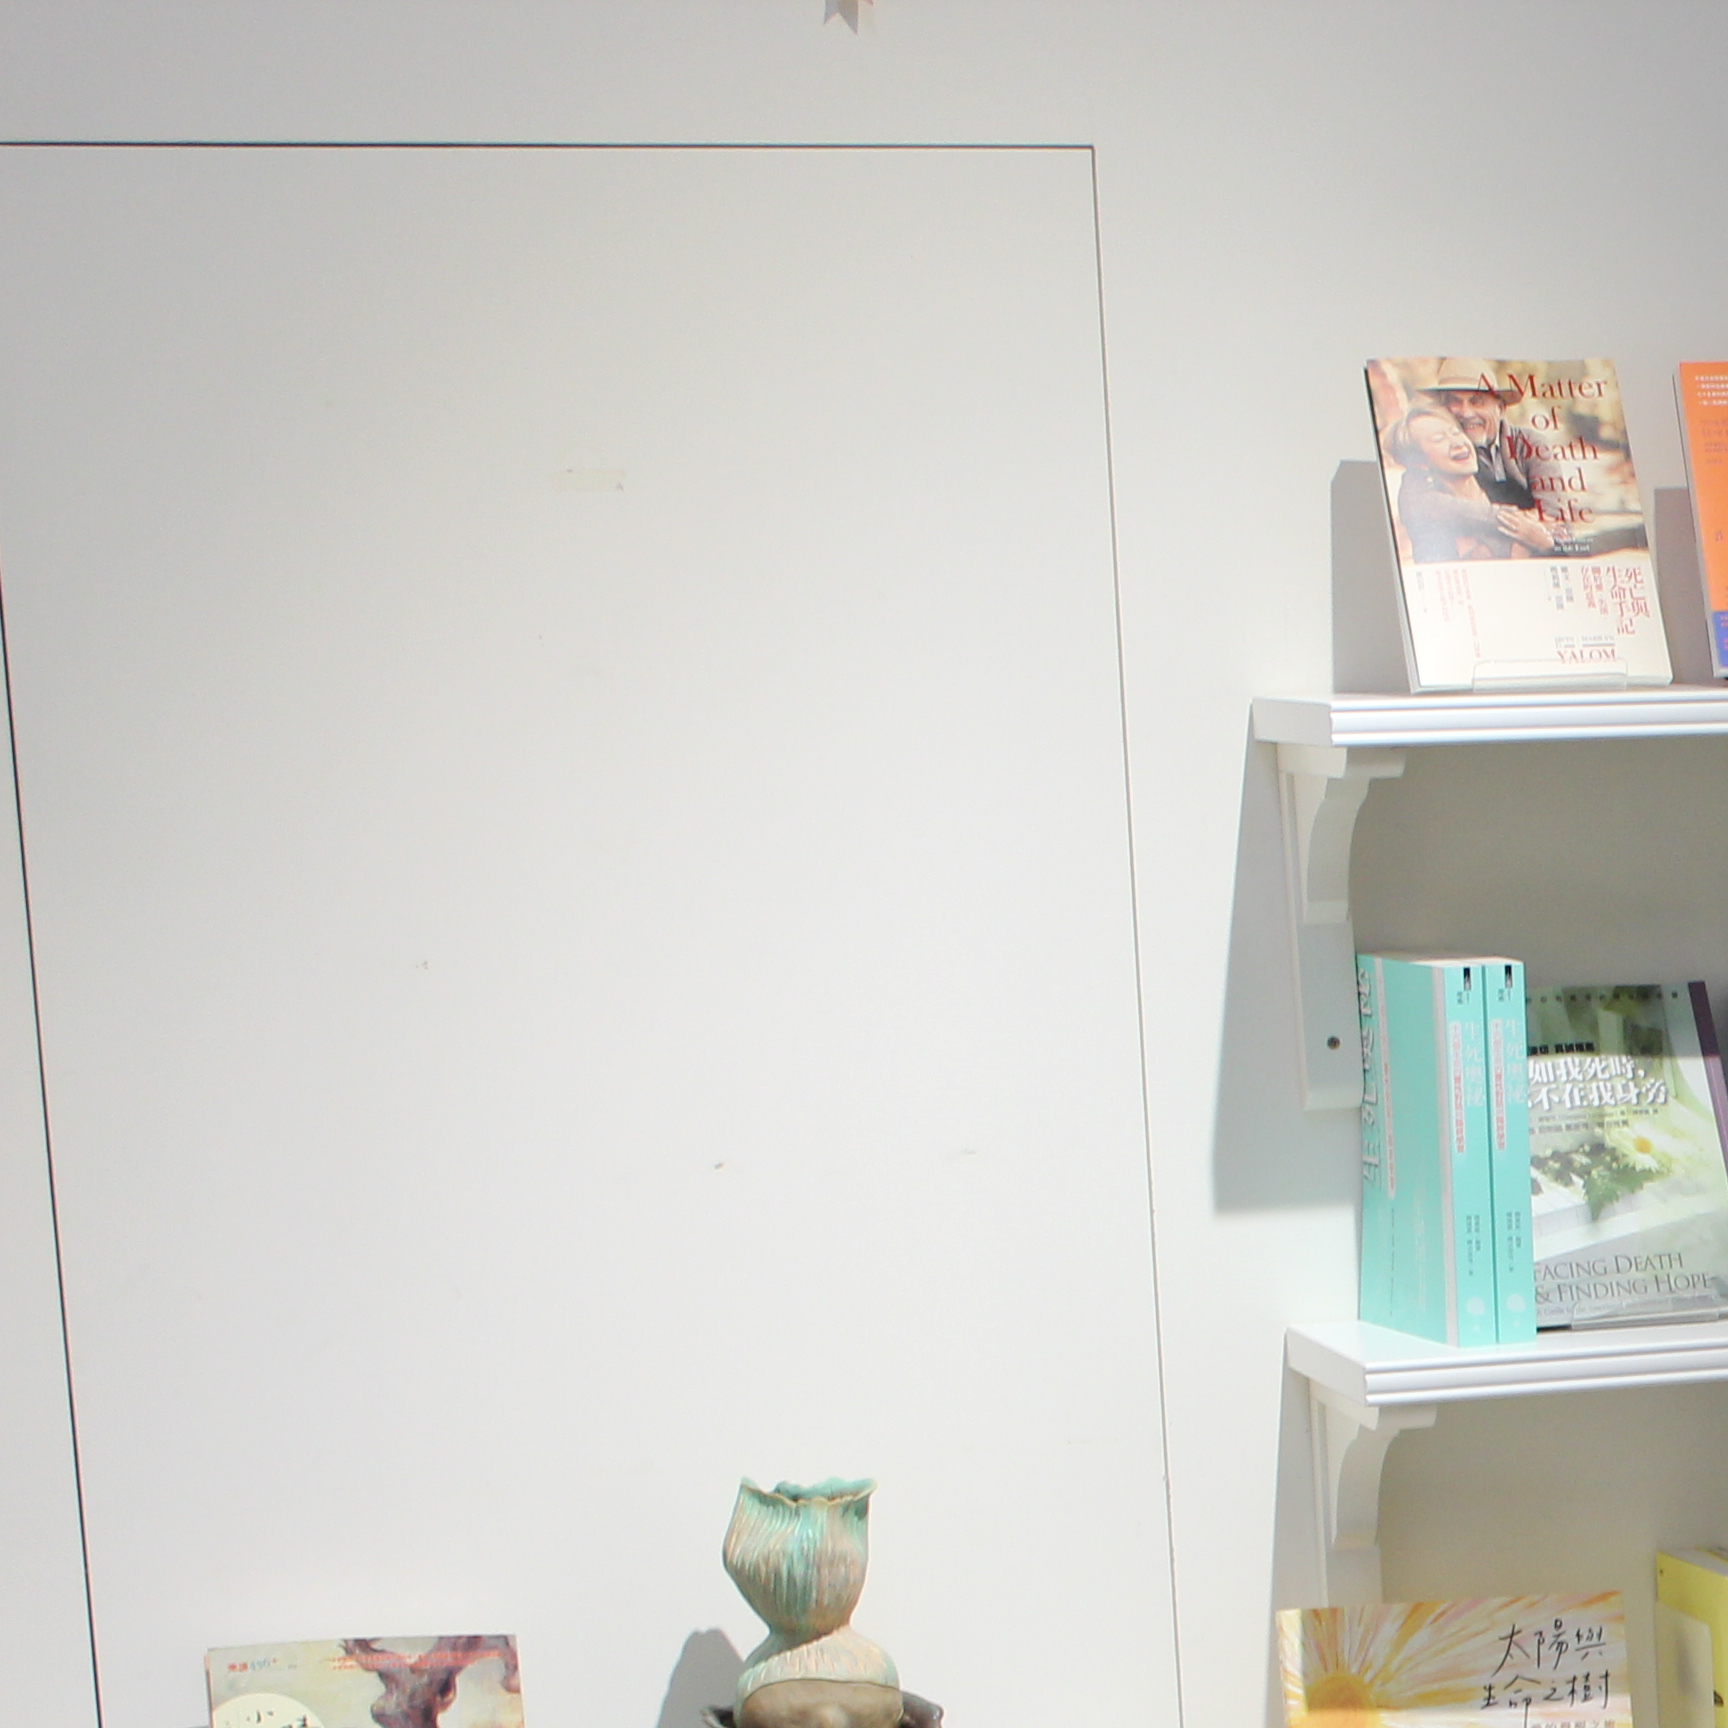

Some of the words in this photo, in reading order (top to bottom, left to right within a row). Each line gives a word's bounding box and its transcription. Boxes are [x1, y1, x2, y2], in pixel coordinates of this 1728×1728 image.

[1476, 372, 1497, 397] A
[1506, 373, 1608, 400] Matter
[1530, 406, 1562, 431] of
[1505, 436, 1600, 461] Death
[1529, 467, 1587, 493] and
[1535, 499, 1594, 524] Life
[1557, 649, 1617, 664] YALOM
[1534, 1260, 1607, 1282] FACING
[1614, 1252, 1684, 1274] DEATH
[1557, 1278, 1649, 1302] FINDING
[1491, 1618, 1608, 1677] 太陽與
